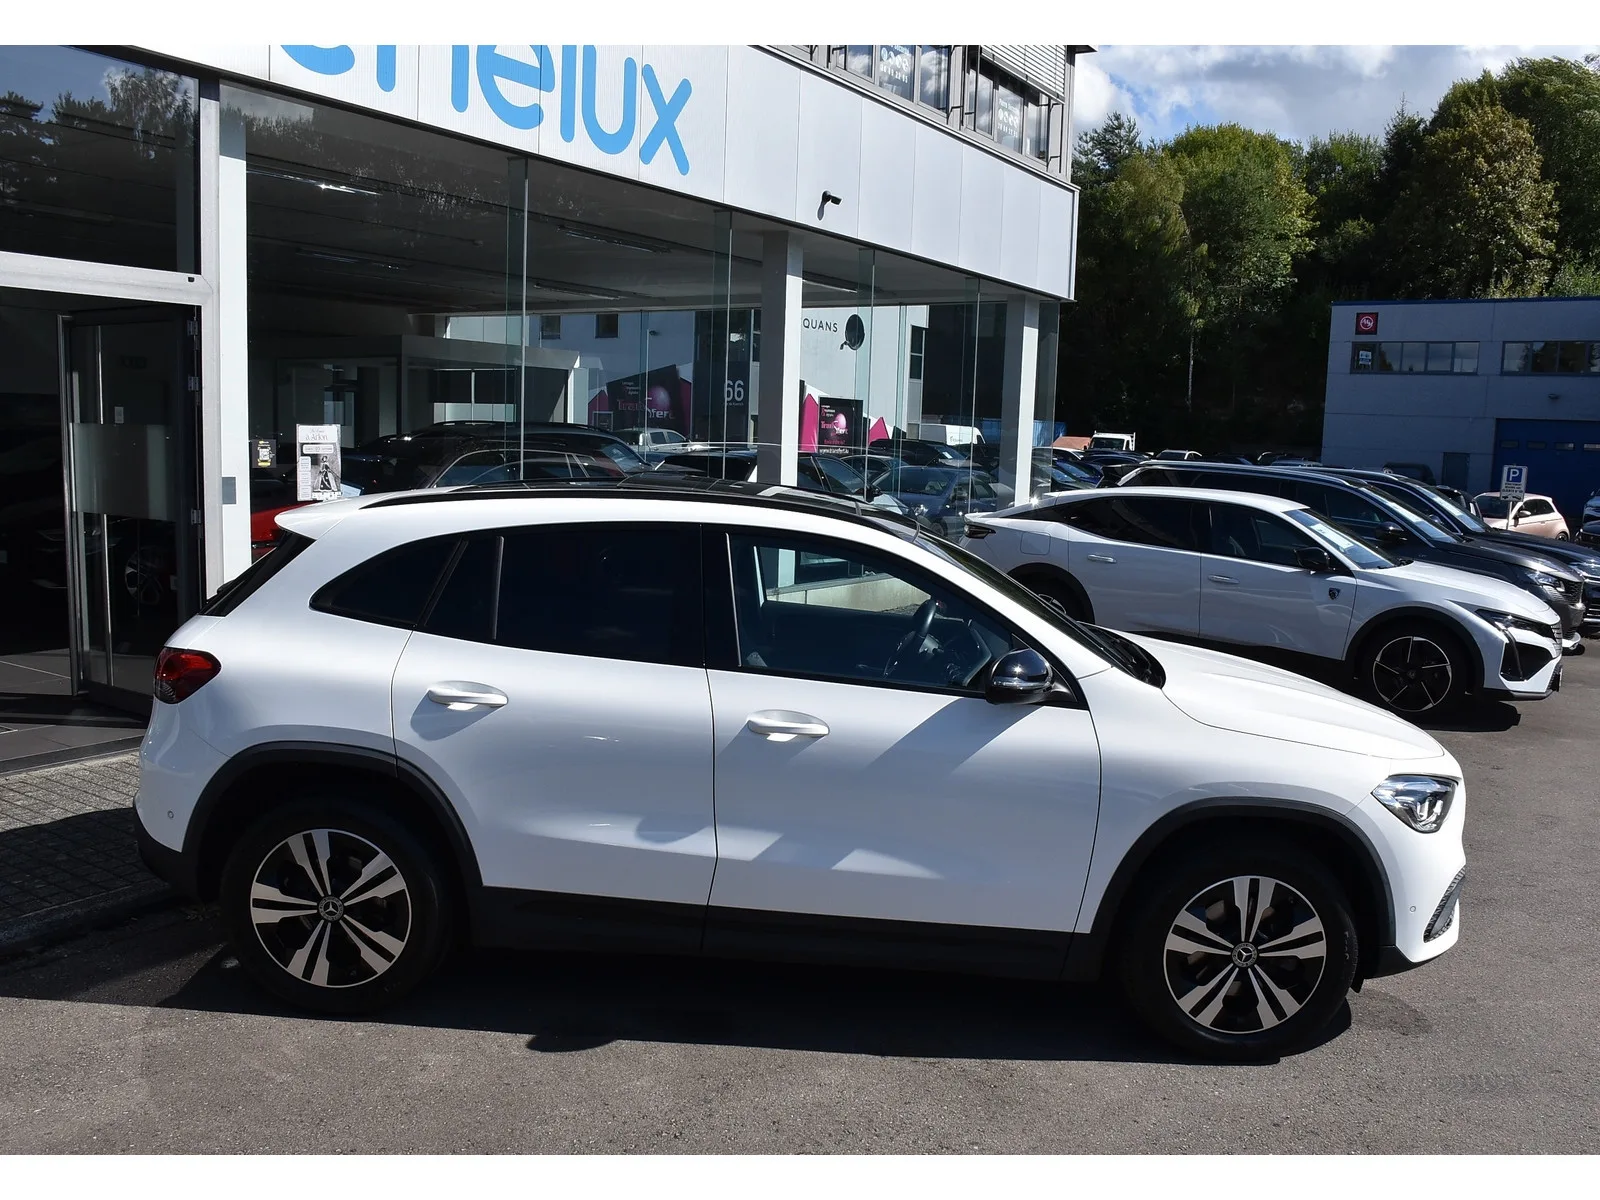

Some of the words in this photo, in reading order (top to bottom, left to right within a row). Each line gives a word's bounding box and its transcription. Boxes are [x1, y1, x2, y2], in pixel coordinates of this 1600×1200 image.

[803, 318, 838, 332] QUANS
[724, 380, 745, 402] 66
[1509, 468, 1520, 481] P
